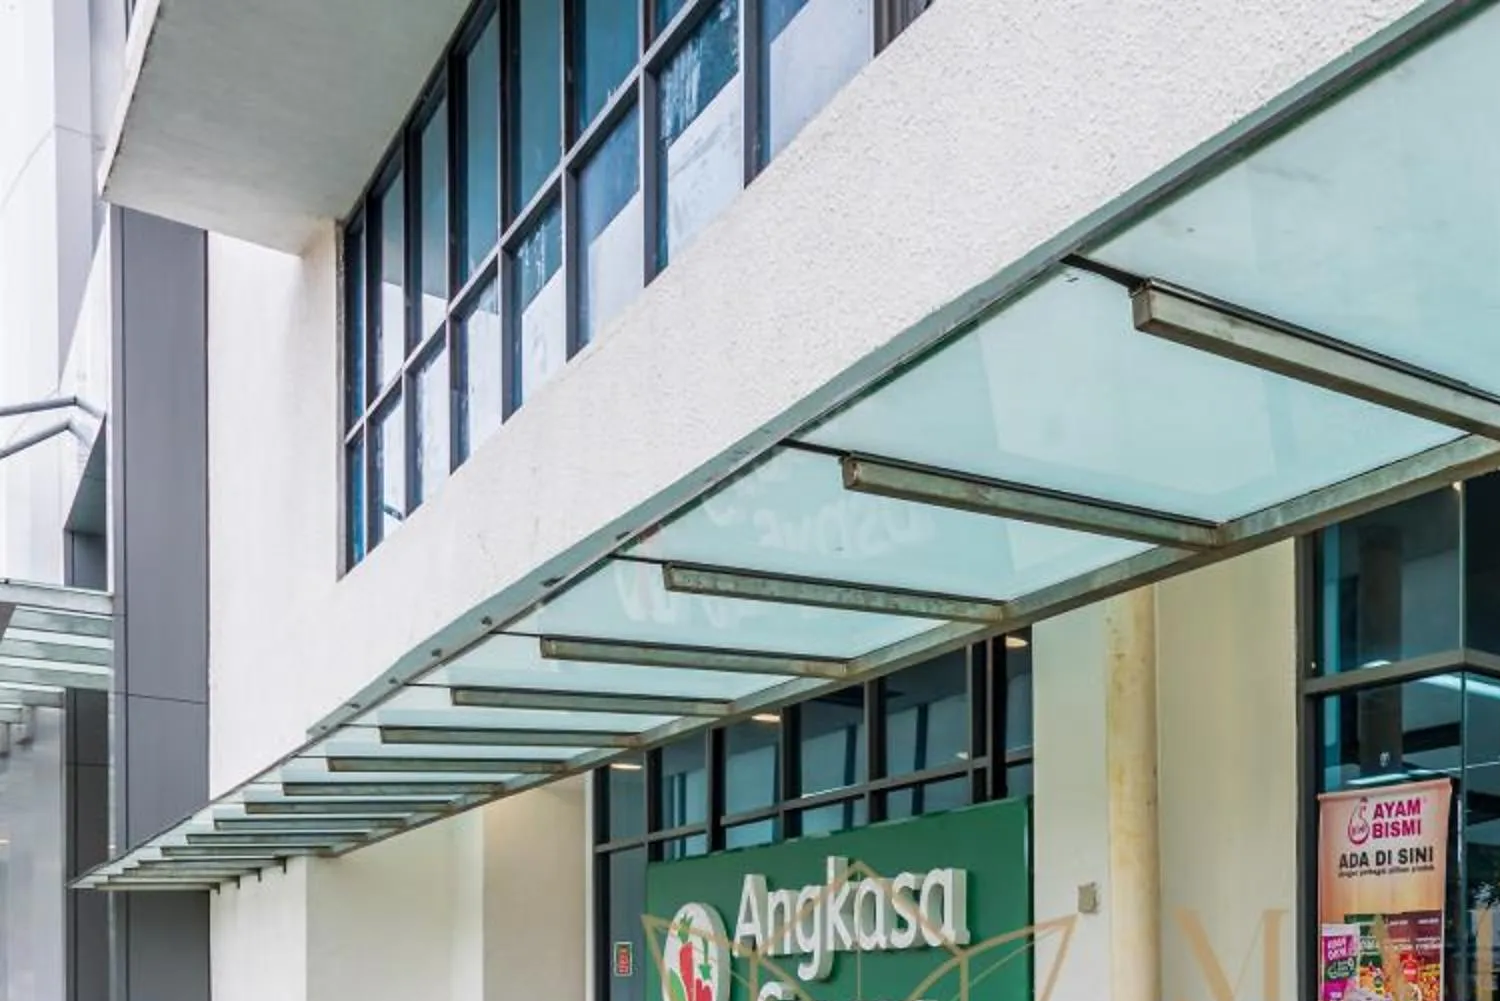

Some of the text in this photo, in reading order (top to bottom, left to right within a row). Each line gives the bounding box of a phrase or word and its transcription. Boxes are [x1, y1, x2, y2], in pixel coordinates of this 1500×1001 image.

[1373, 798, 1421, 819] AYAM
[1372, 820, 1421, 839] BISMI
[1339, 846, 1433, 869] ADA DI SINI
[732, 855, 971, 981] Angkasa
